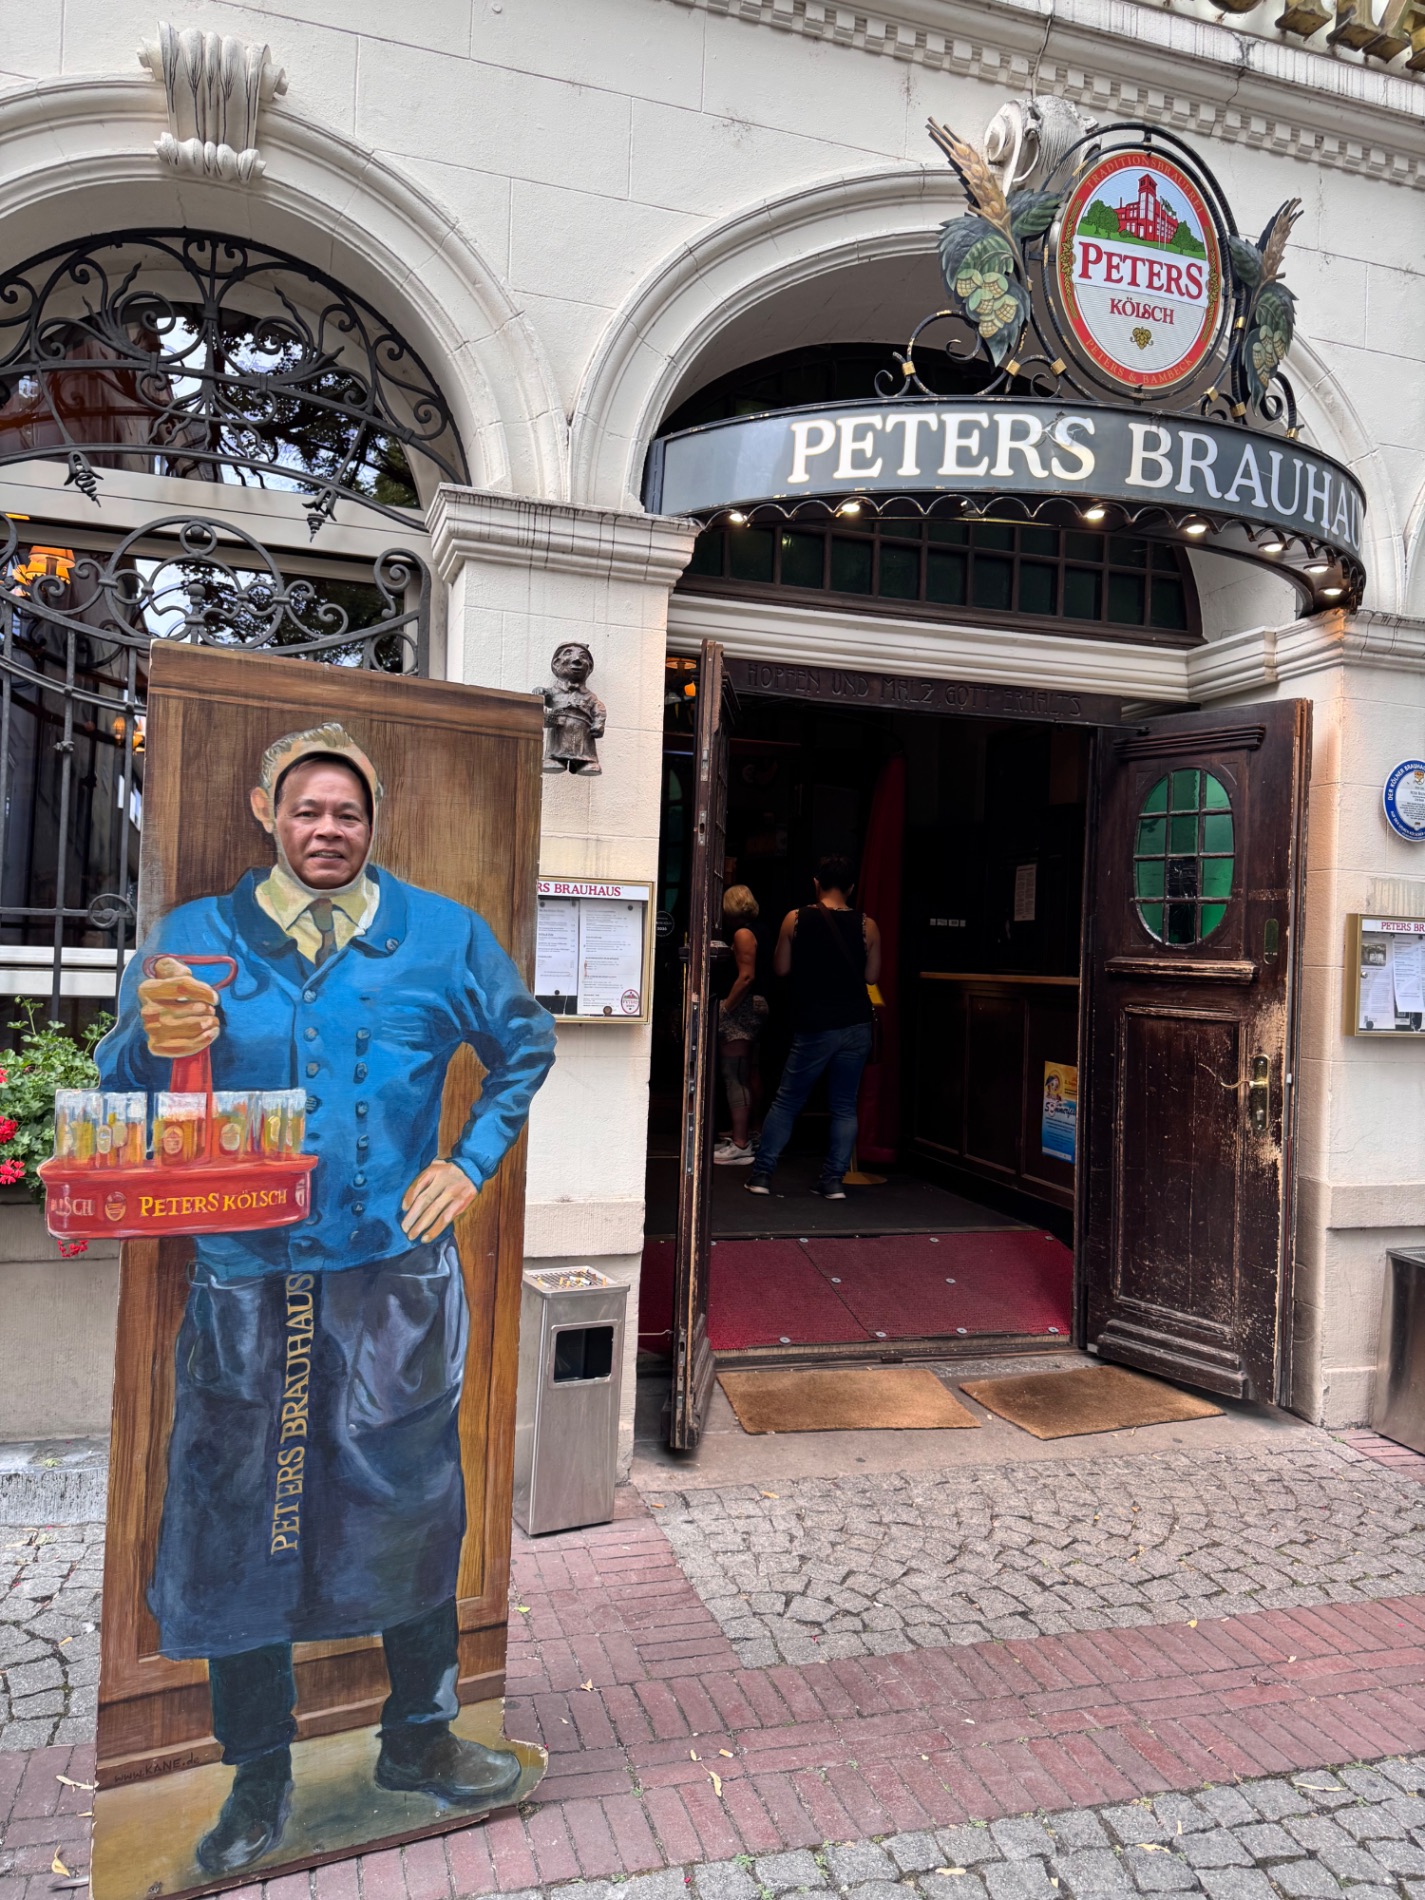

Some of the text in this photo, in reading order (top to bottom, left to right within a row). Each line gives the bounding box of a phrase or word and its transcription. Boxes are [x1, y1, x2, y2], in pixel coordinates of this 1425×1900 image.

[1085, 154, 1204, 214] TRADITIONSBRAUEREI
[1078, 241, 1203, 300] PETERS
[1109, 297, 1175, 325] KÖLSCH
[1085, 338, 1194, 384] PETERS & BAMBECK
[787, 412, 1096, 481] PETERS
[747, 664, 820, 694] HOPFEN
[832, 672, 869, 698] UND
[945, 684, 995, 709] GOTT
[554, 883, 621, 897] BRAUHAUS
[1381, 921, 1411, 931] PETERS
[139, 1189, 287, 1217] PETERS KÖLSCH
[270, 1272, 315, 1556] PETERS BRAUHAUS
[114, 1752, 200, 1783] www.KANE.de
